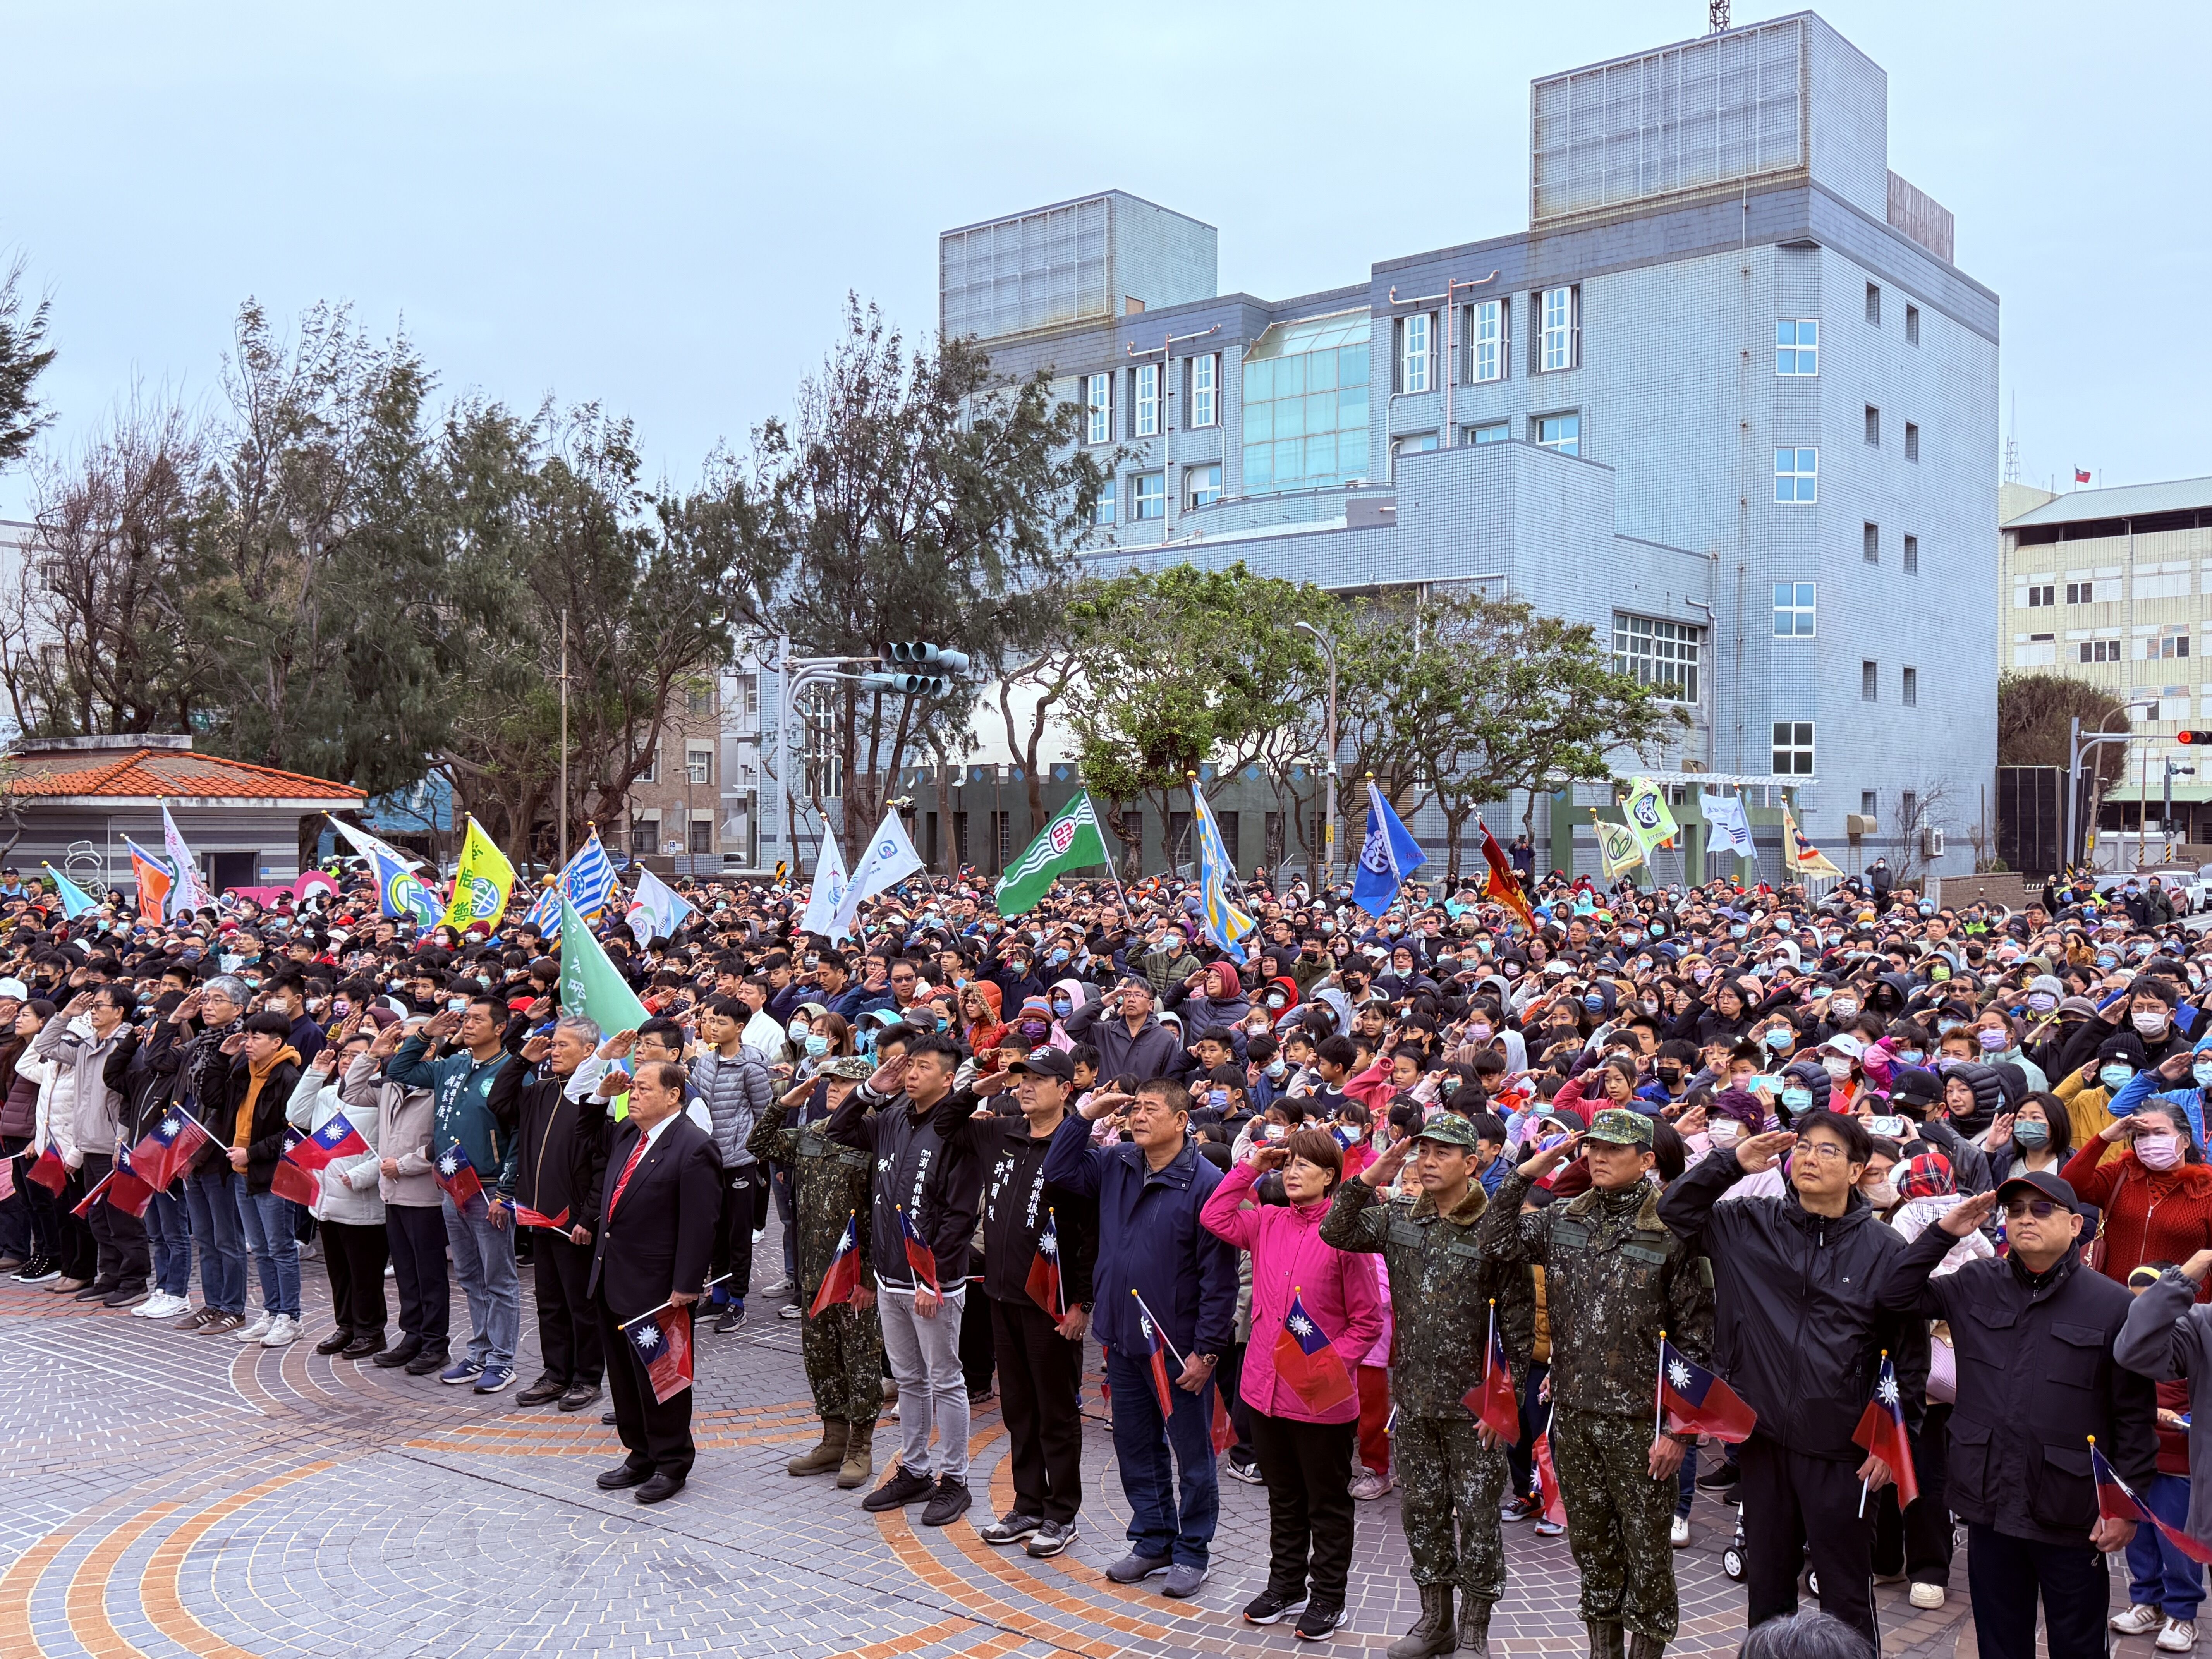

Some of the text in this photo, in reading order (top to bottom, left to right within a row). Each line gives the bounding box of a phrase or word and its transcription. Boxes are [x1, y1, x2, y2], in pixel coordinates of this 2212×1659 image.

[909, 1157, 929, 1220] 澎湖縣議會
